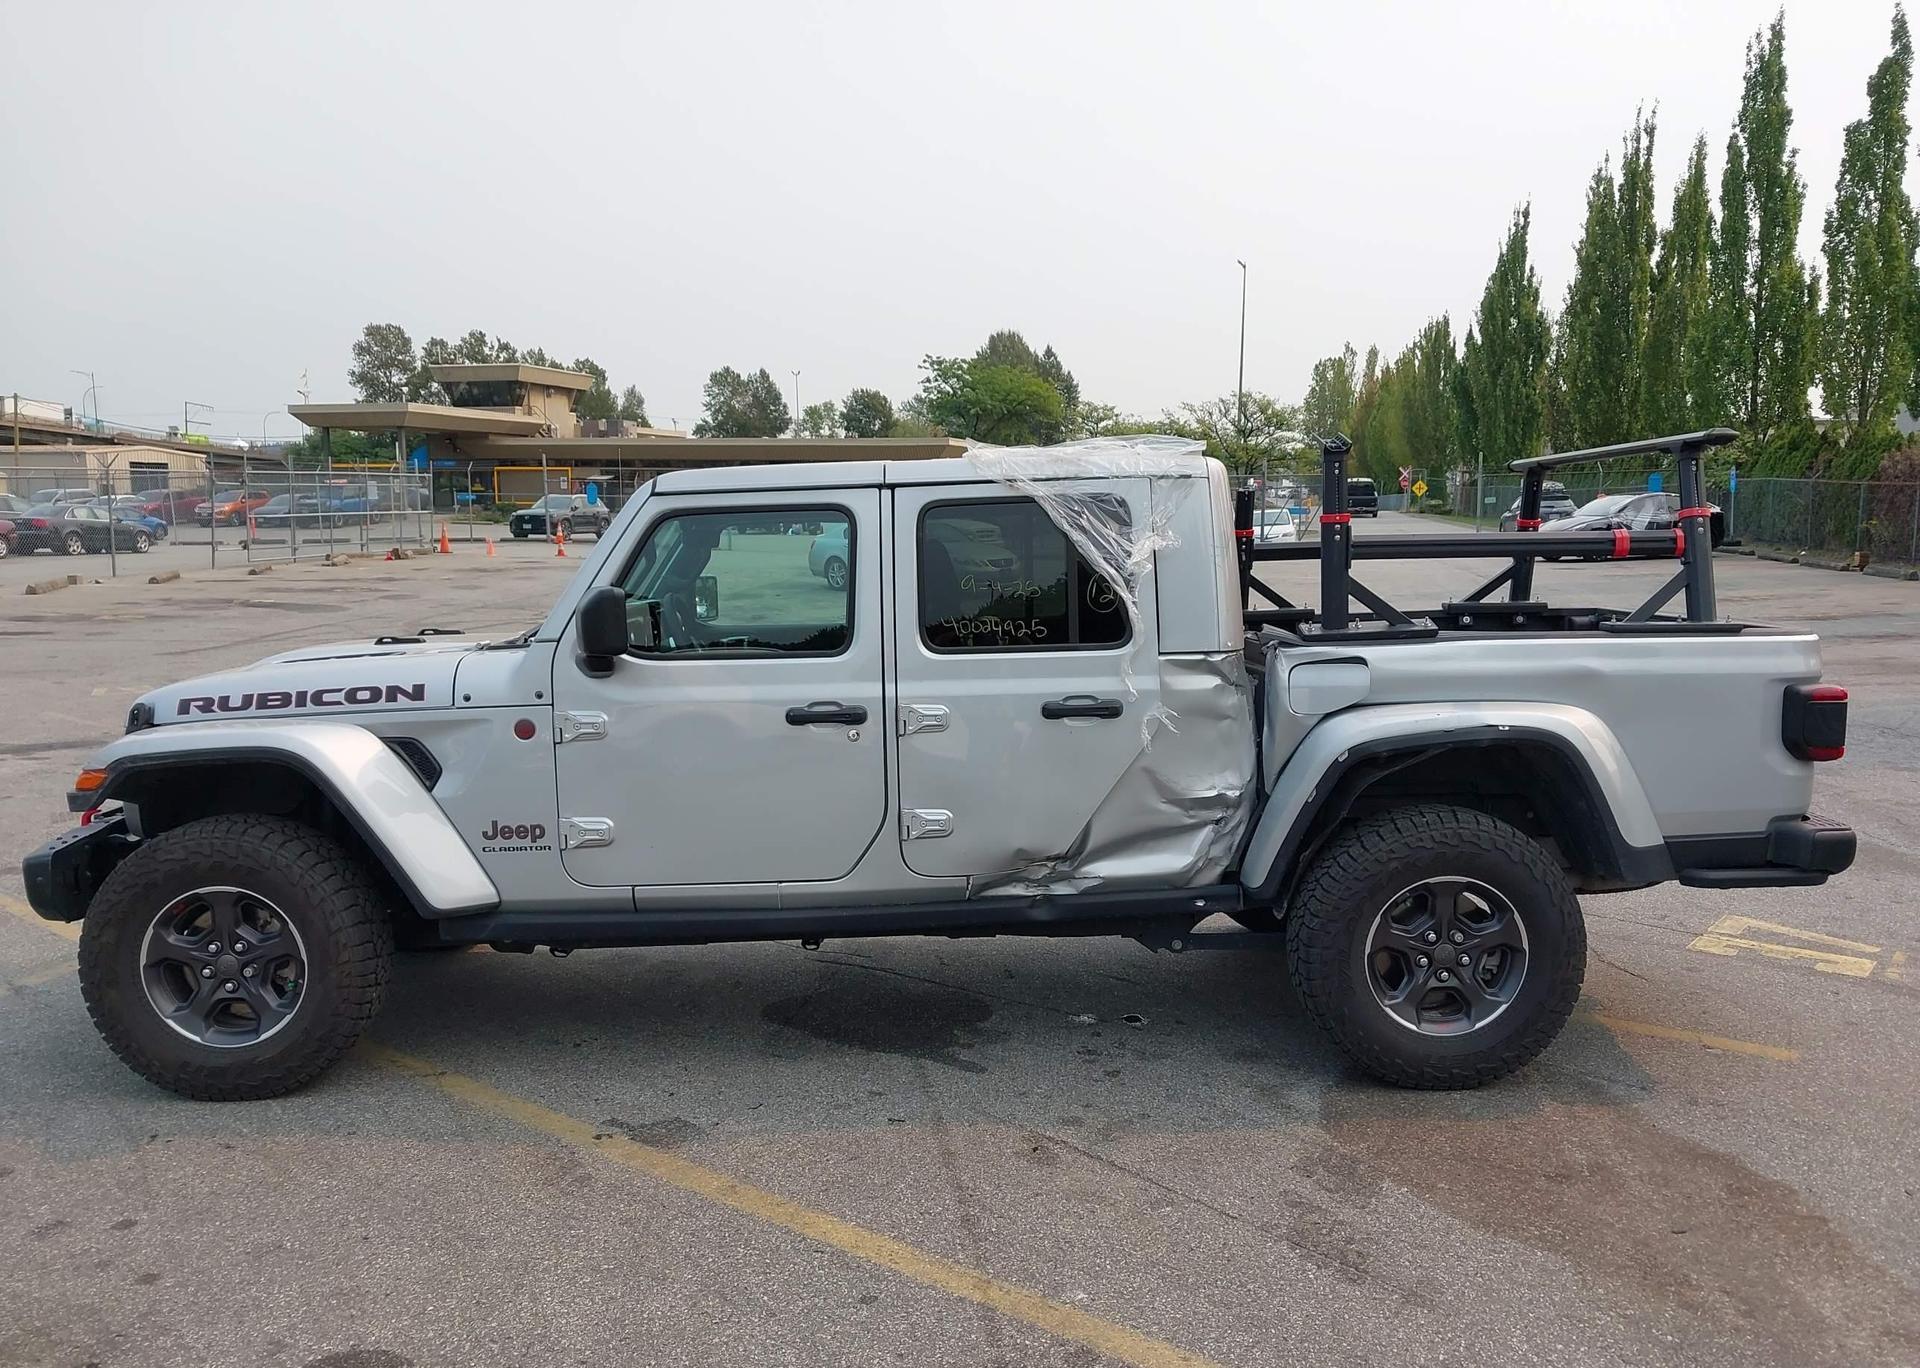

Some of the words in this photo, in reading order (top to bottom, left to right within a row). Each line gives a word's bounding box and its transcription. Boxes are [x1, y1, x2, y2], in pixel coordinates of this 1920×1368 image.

[176, 683, 426, 716] RUBICON
[481, 819, 546, 843] Jeep
[481, 845, 552, 853] GLADIATOR
